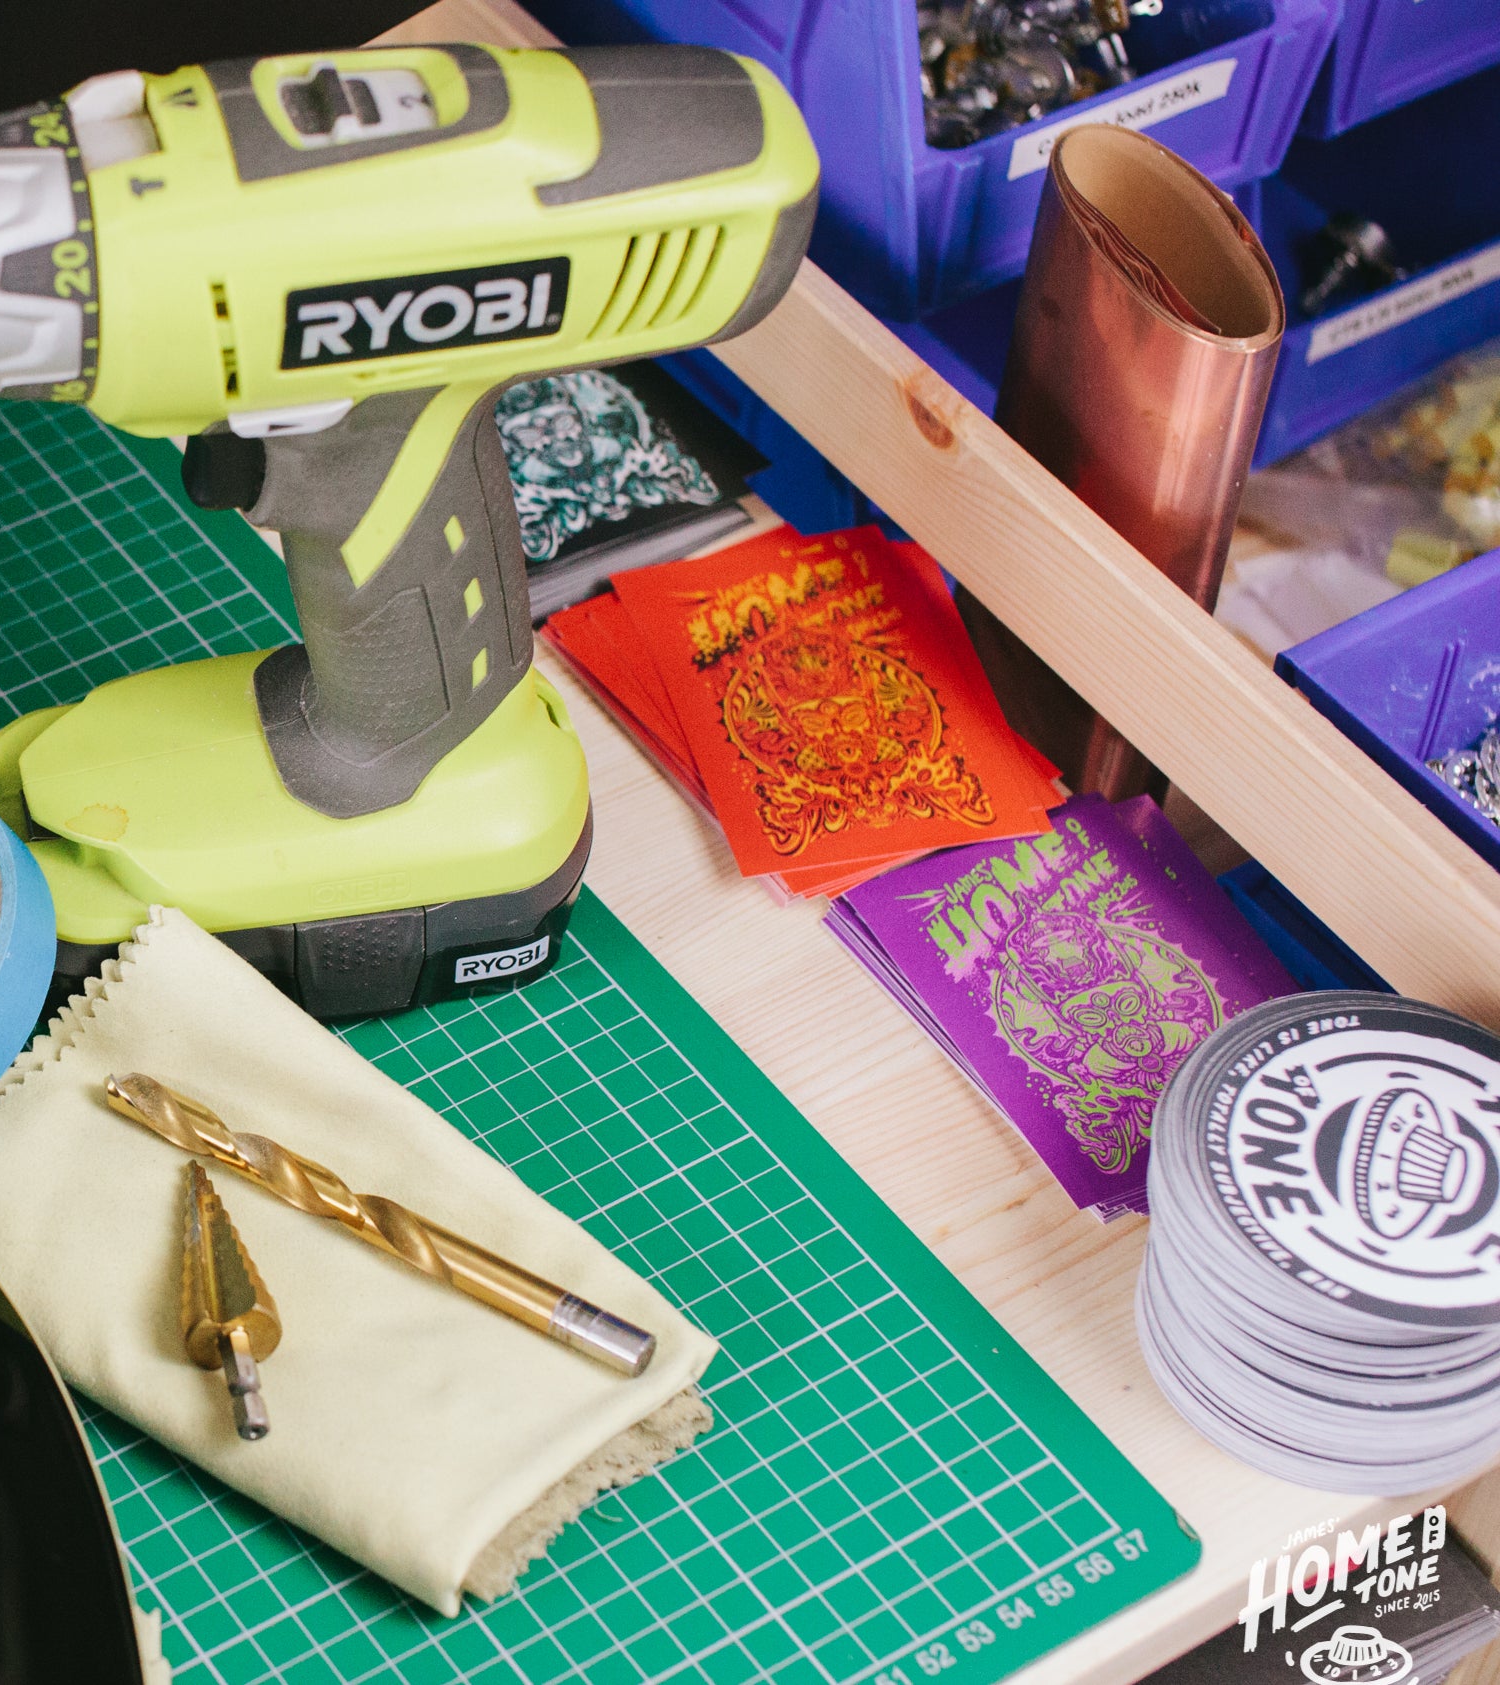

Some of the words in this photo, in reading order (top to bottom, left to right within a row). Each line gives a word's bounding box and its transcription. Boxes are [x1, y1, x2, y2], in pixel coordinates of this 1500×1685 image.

[51, 239, 92, 298] 20
[297, 272, 552, 360] RYOBI
[927, 830, 1067, 965] HOME
[462, 945, 541, 977] RYOBI
[1277, 1028, 1300, 1045] IS
[1306, 1015, 1361, 1035] TONE
[1206, 1083, 1237, 1156] TOTALLY
[1293, 1075, 1317, 1098] OF
[1240, 1064, 1323, 1219] TONE
[915, 1642, 957, 1676] 52
[955, 1619, 996, 1652] 53
[995, 1597, 1036, 1629] 54
[1035, 1574, 1075, 1606] 55
[1074, 1551, 1116, 1584] 56
[1113, 1528, 1149, 1561] 57
